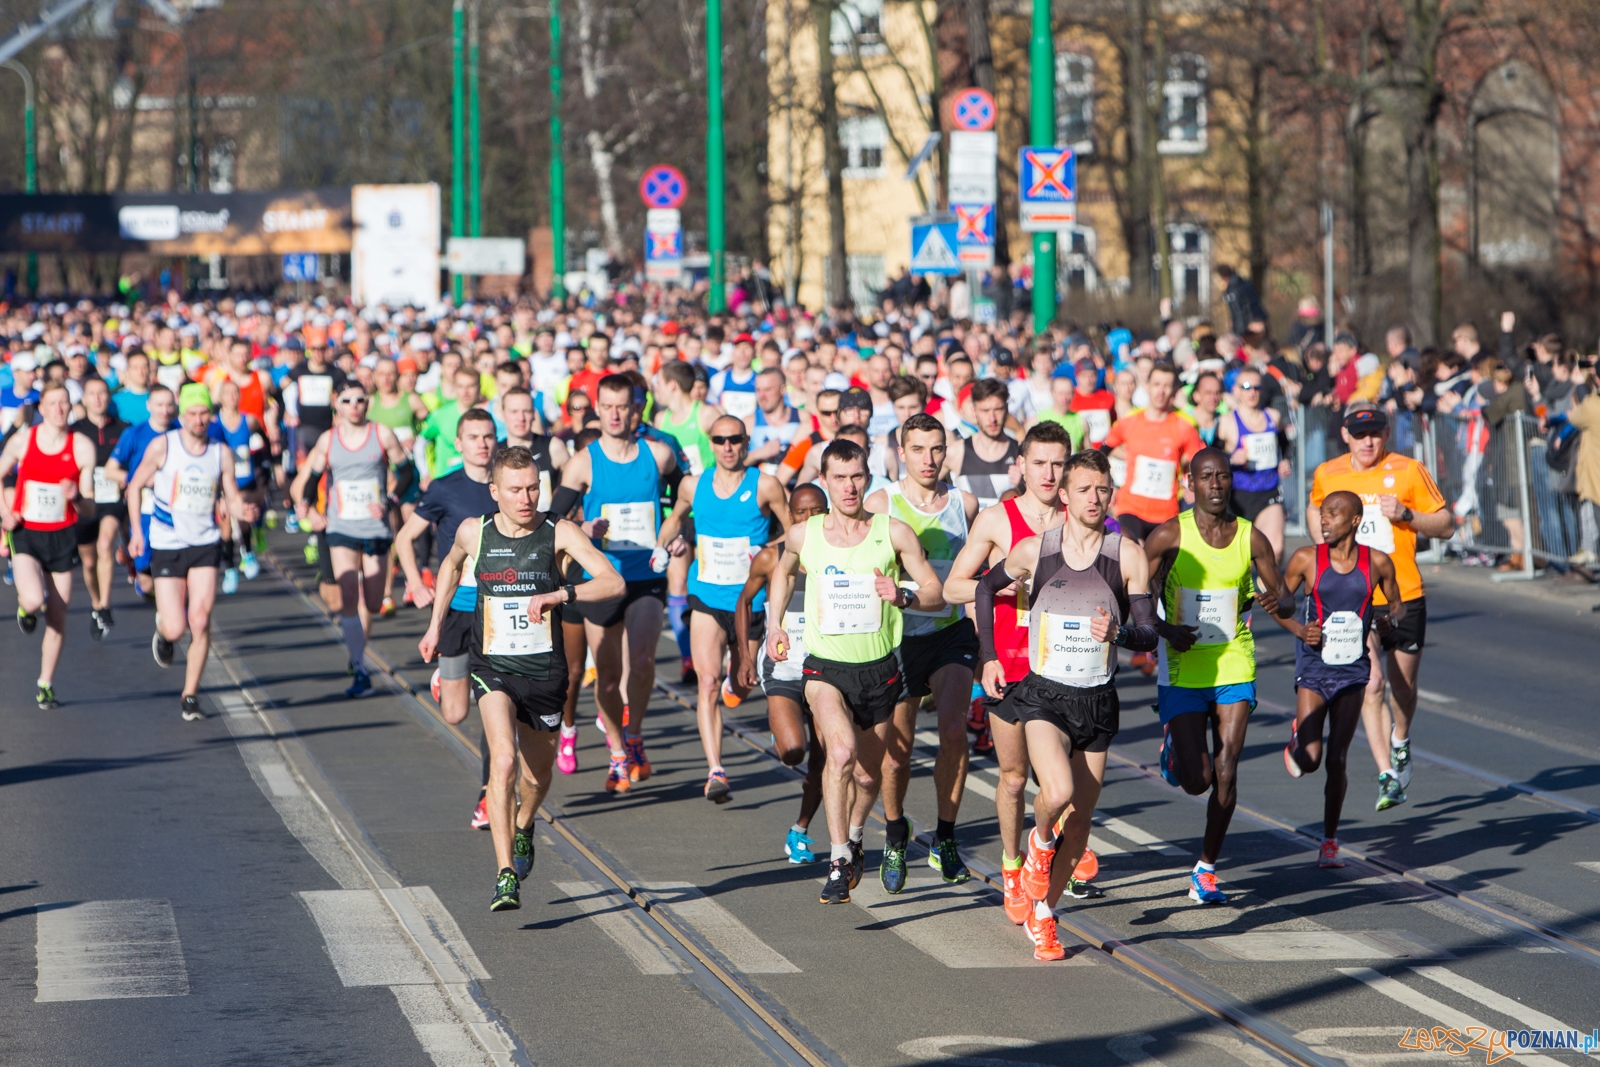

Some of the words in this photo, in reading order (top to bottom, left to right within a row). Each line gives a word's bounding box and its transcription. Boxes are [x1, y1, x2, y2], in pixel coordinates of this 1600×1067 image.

[263, 209, 328, 233] START
[1357, 520, 1376, 534] 61
[517, 571, 551, 580] METAL
[492, 583, 537, 592] OSTROŁĘKA
[509, 614, 529, 630] 15
[1065, 635, 1092, 643] Marcin
[1053, 643, 1101, 653] Chabowski
